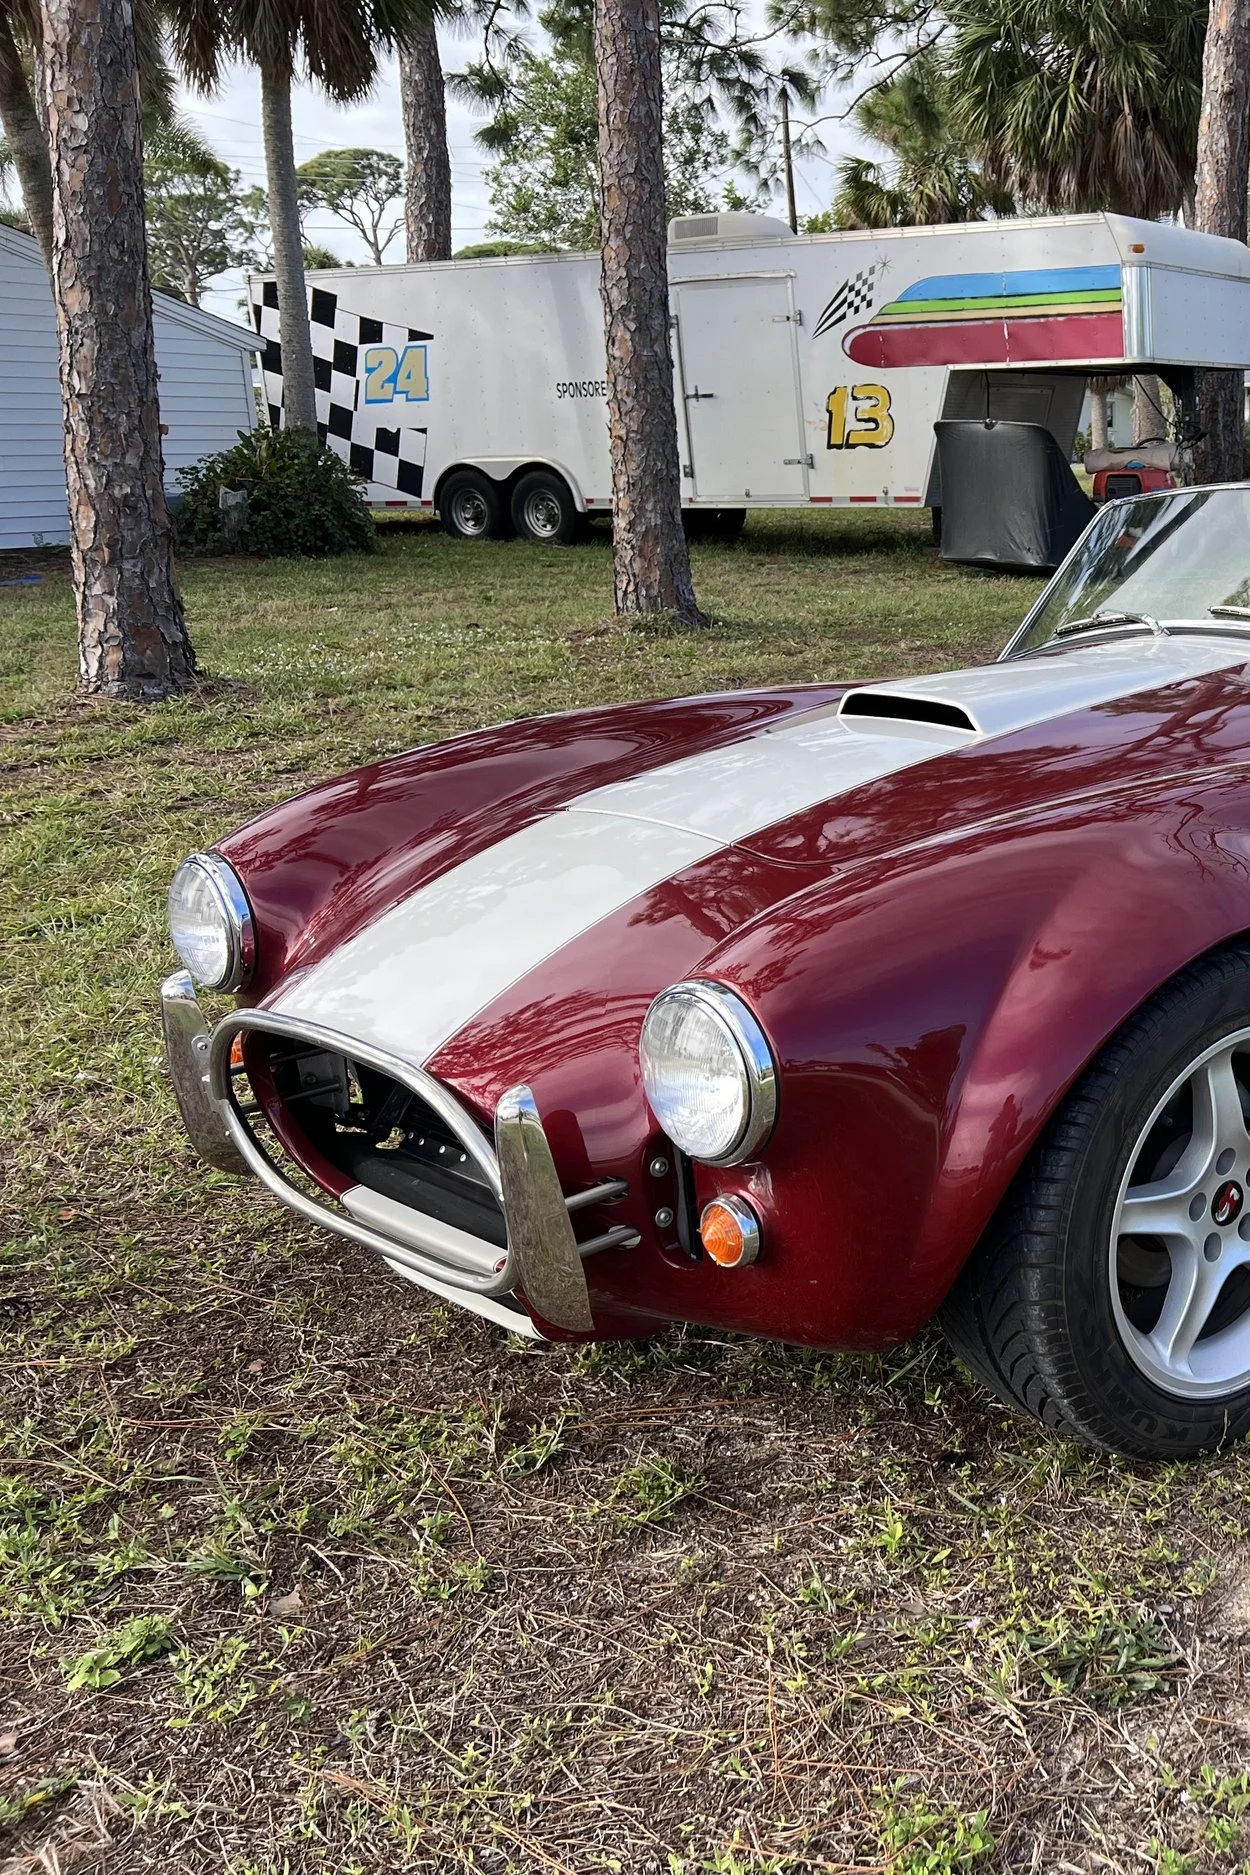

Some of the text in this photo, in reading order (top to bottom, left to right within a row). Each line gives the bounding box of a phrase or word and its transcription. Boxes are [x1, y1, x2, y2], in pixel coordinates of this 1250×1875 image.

[365, 345, 430, 404] 24
[556, 381, 608, 399] SPONSORE
[826, 383, 895, 450] 13
